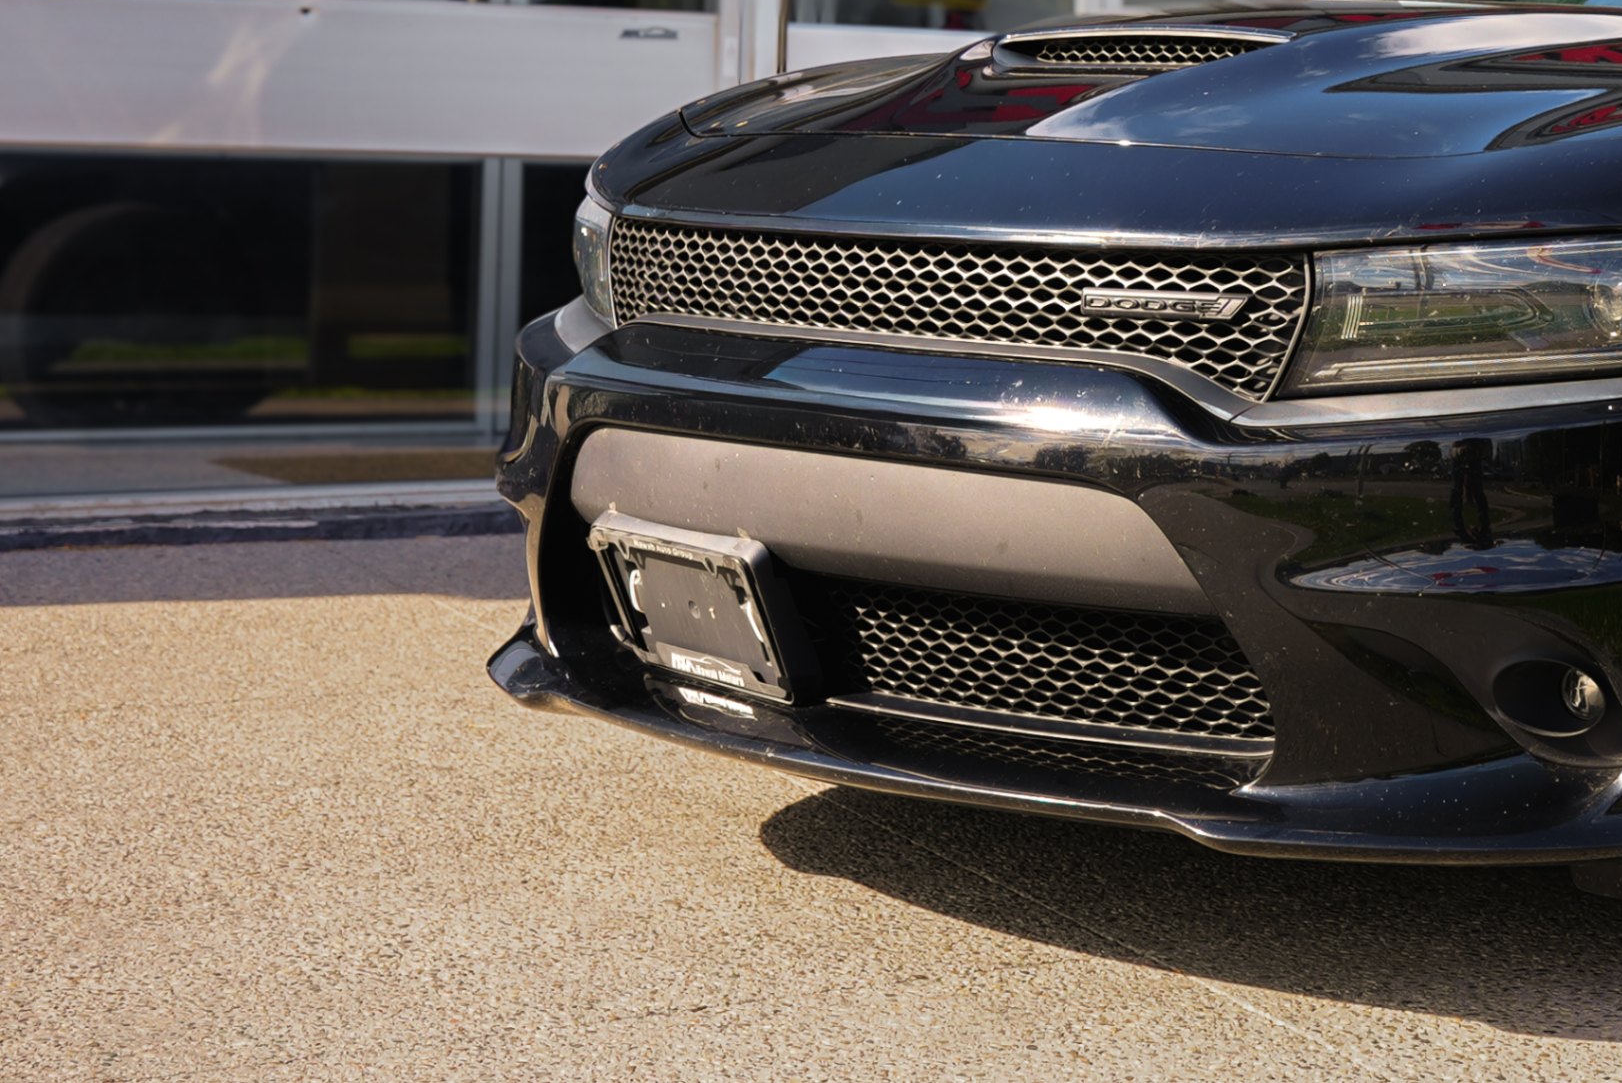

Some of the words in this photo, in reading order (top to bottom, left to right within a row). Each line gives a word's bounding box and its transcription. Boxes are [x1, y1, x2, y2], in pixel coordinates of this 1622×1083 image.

[1088, 296, 1223, 315] DODGE
[632, 538, 656, 552] Nawab
[656, 544, 671, 555] Auto
[671, 547, 693, 560] Group
